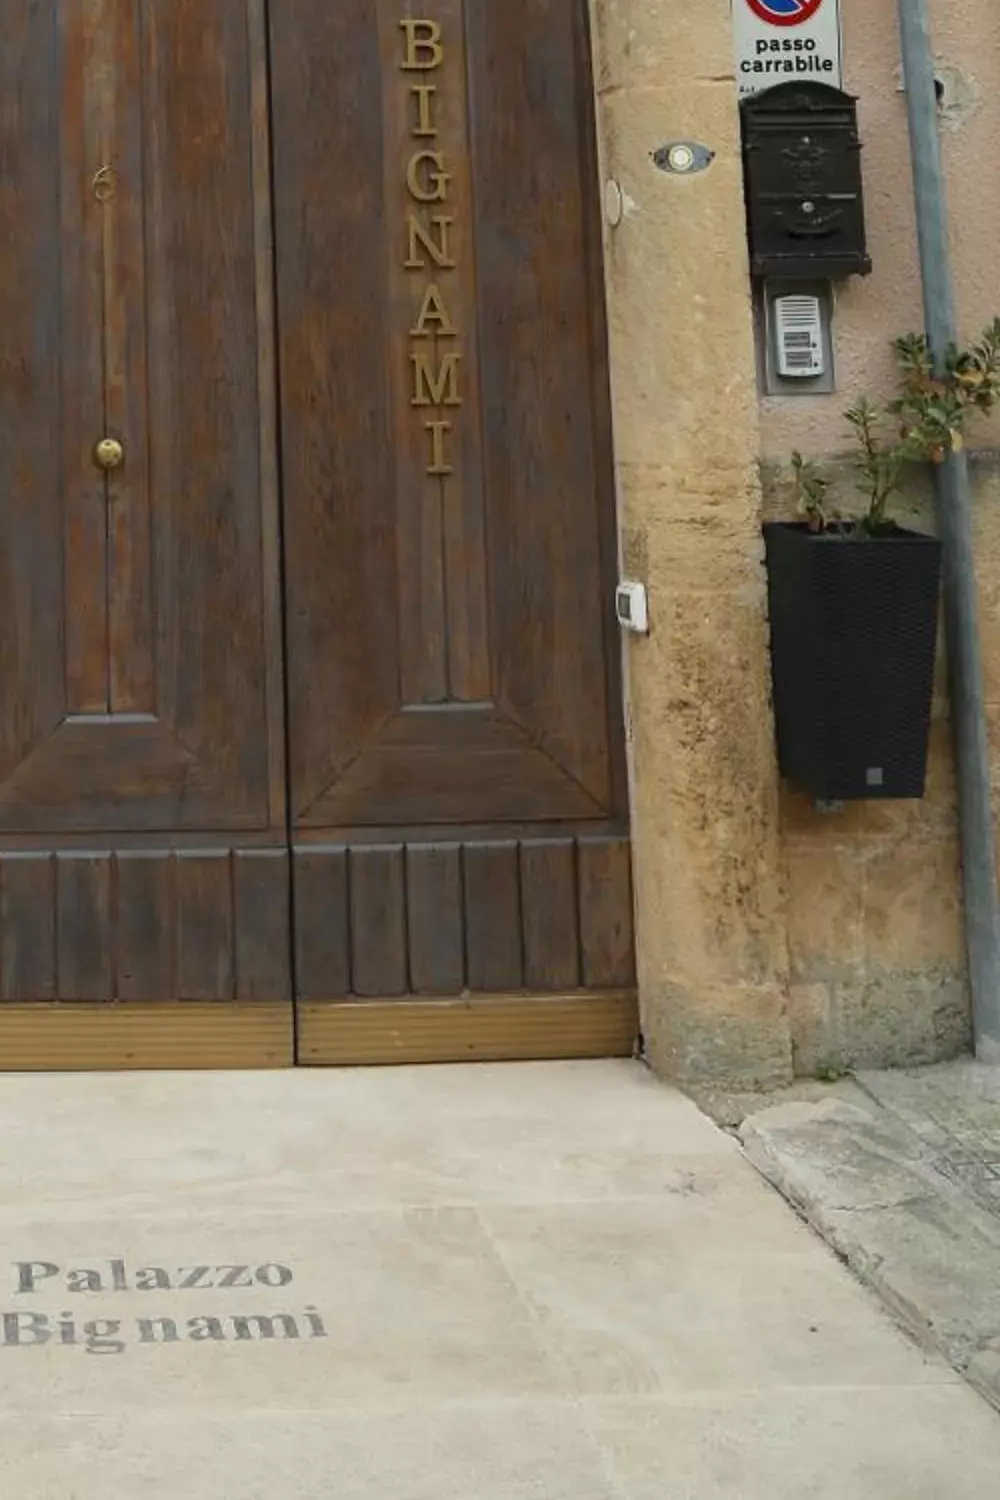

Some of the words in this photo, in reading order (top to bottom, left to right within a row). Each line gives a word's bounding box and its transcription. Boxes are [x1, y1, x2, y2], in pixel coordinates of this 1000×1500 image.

[740, 55, 834, 73] carrabile
[756, 38, 816, 55] passo
[399, 18, 463, 476] BIGNAMI
[11, 1259, 293, 1294] Palazzo
[0, 1304, 329, 1355] Bignami
